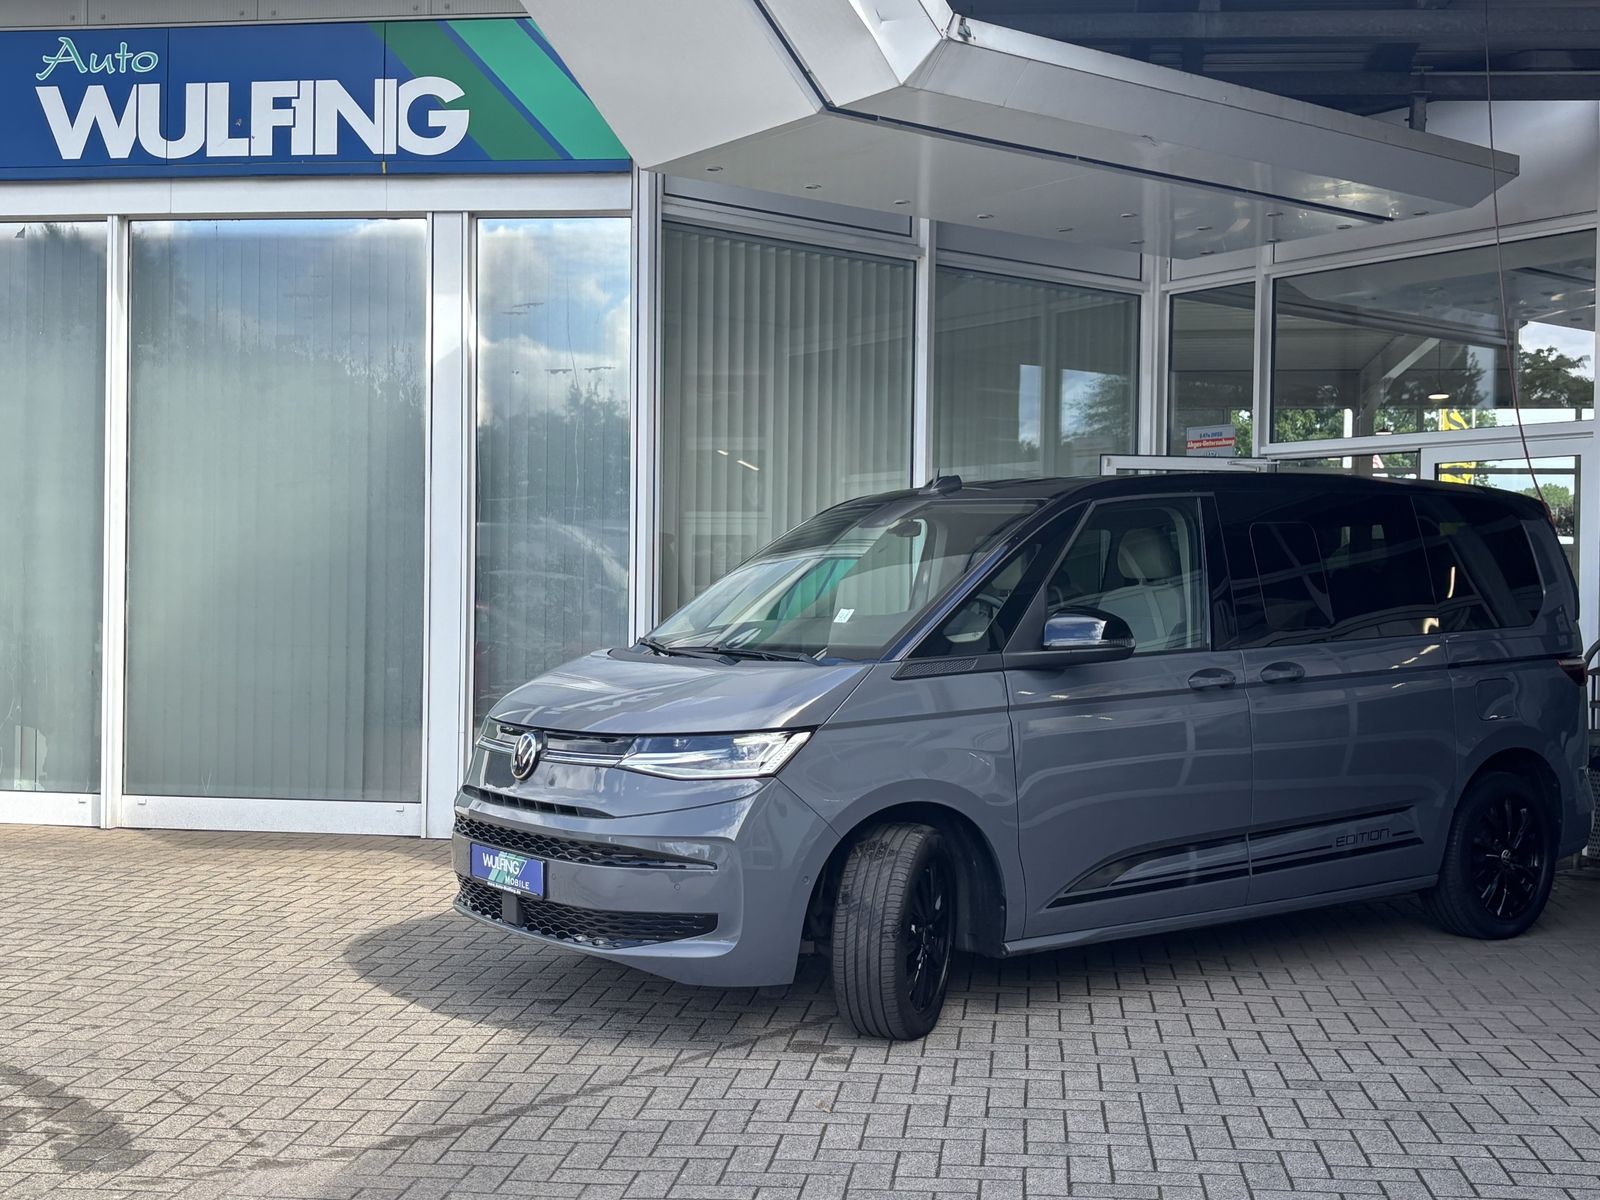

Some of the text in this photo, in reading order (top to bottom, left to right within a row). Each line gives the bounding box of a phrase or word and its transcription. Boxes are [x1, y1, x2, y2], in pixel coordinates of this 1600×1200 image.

[34, 36, 160, 81] Auto
[35, 75, 470, 161] WULFING
[1336, 828, 1390, 848] EDITION
[482, 852, 520, 875] WULFING
